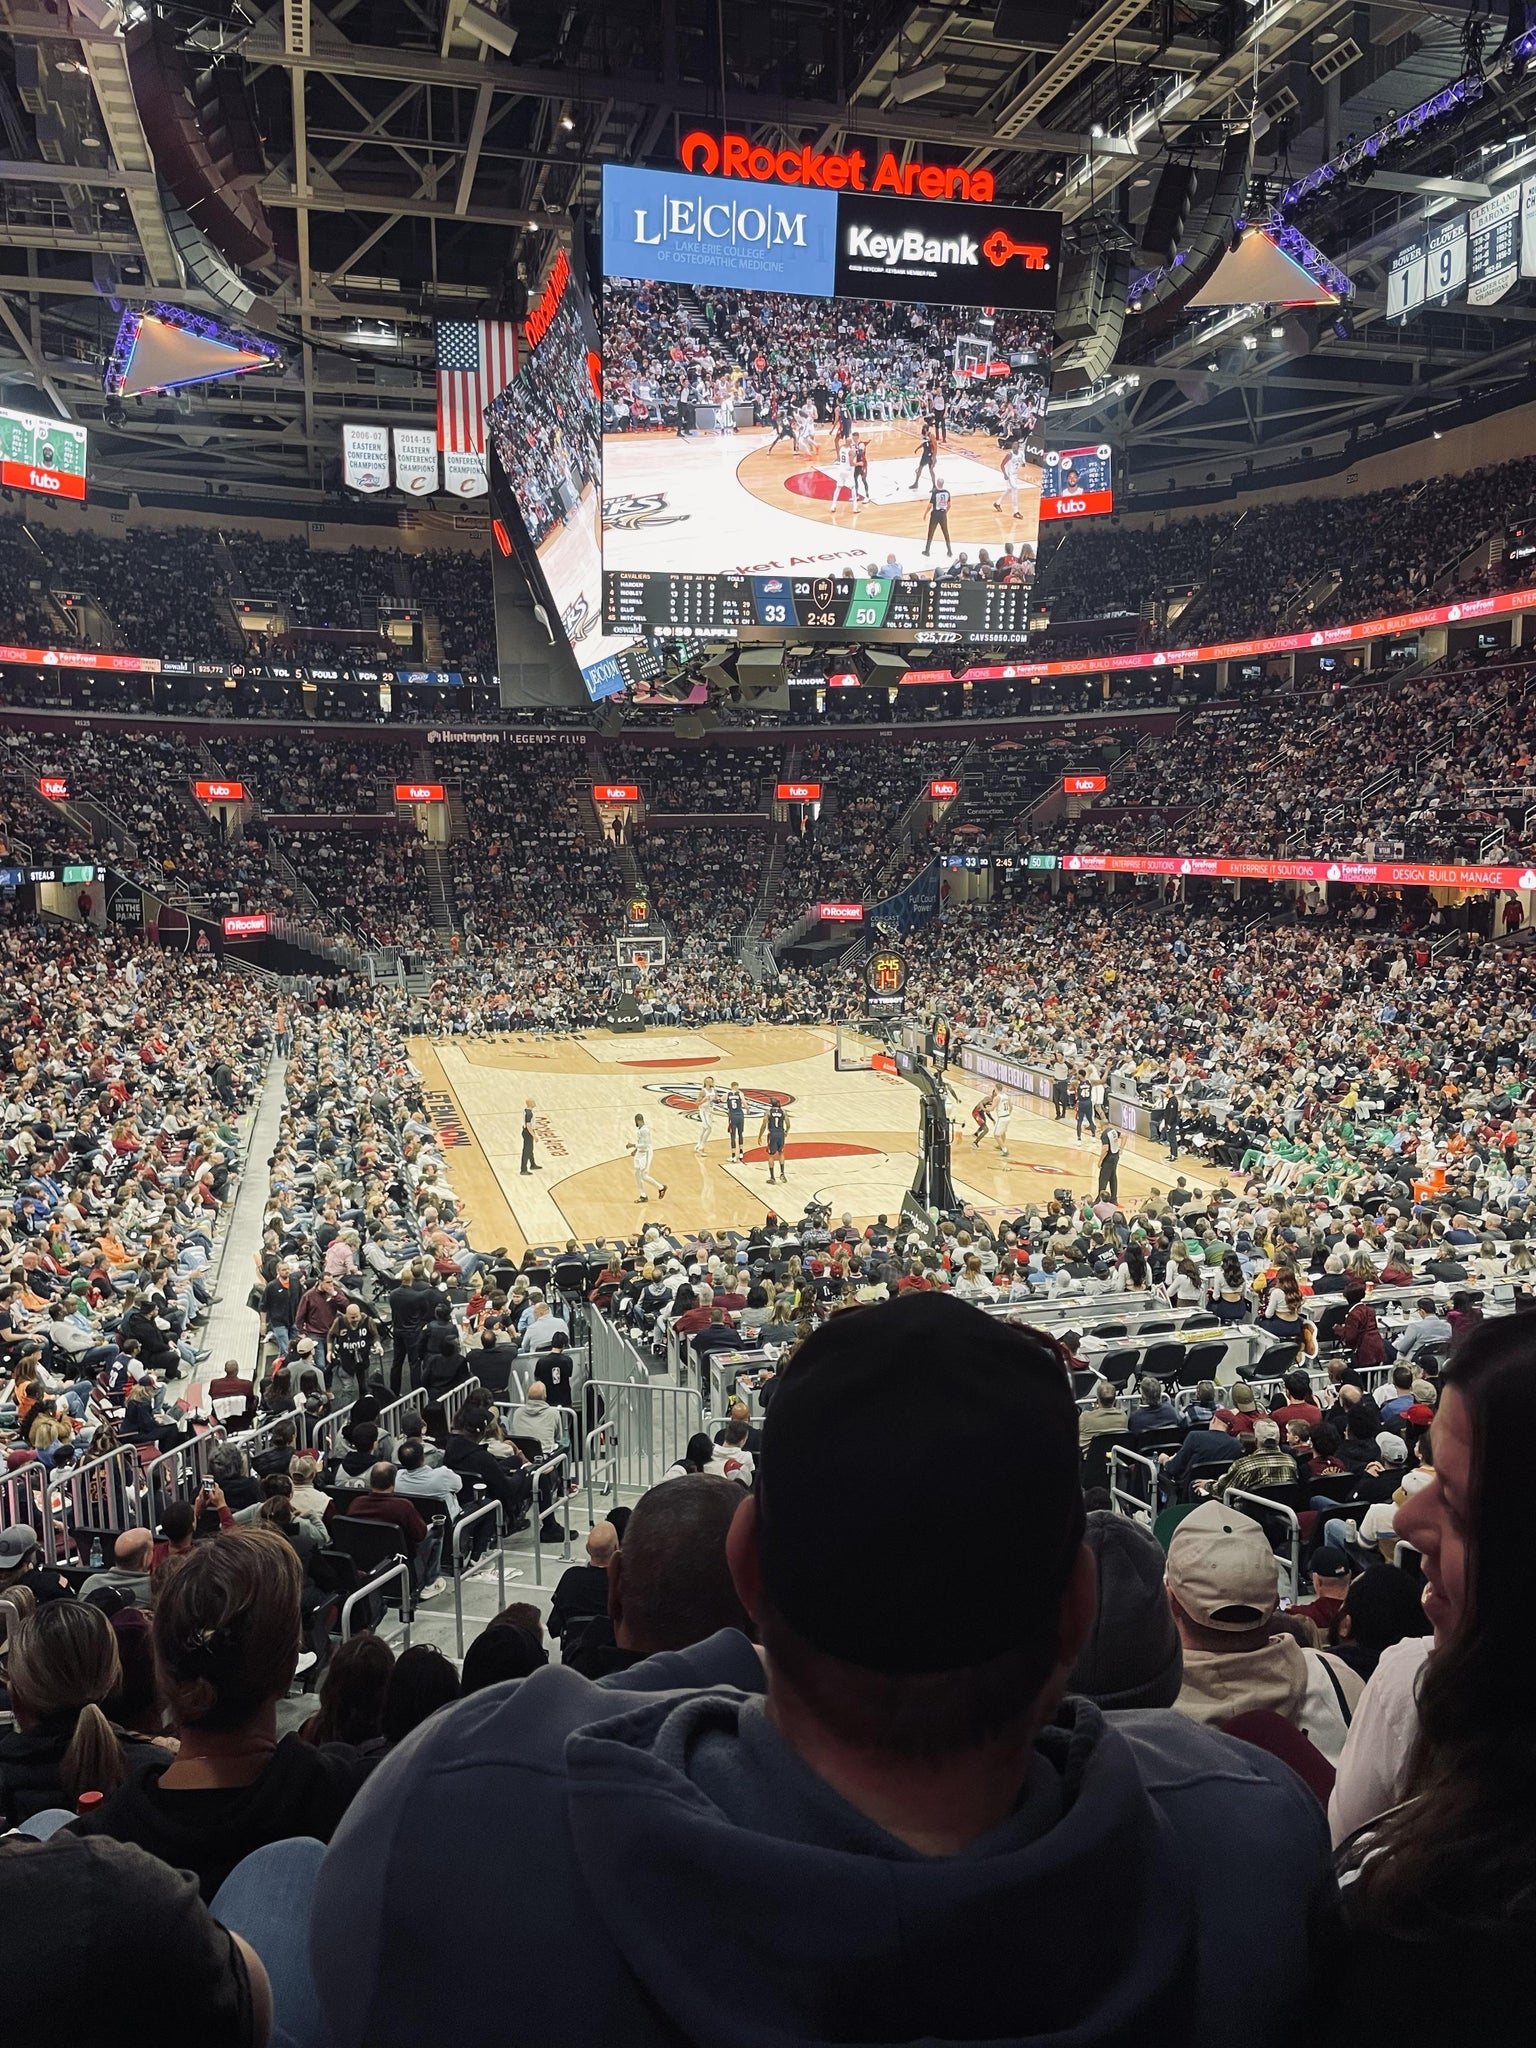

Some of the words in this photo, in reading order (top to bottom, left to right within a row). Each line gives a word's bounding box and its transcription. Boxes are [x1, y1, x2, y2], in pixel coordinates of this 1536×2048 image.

[722, 134, 866, 190] Rocket
[872, 151, 995, 202] Arena
[1471, 190, 1518, 220] CLEVELAND
[1478, 204, 1510, 227] BARONS
[1430, 224, 1465, 249] GLOVER
[848, 225, 979, 265] KeyBank
[675, 241, 700, 252] LAKE
[701, 243, 722, 255] ERIE
[723, 247, 765, 260] COLLEGE
[657, 250, 671, 261] OF
[672, 252, 737, 269] OSTEOPATHIC
[738, 258, 784, 273] MEDICINE
[1393, 247, 1421, 269] BOWER
[1440, 250, 1451, 287] 9
[1402, 270, 1409, 306] 1
[351, 431, 382, 440] 2006-07
[401, 435, 432, 444] 2014-15
[352, 442, 381, 450] EASTERN
[402, 446, 430, 454] EASTERN
[348, 451, 387, 461] CONFERENCE
[398, 454, 436, 464] CONFERENCE
[447, 456, 486, 466] CONFERENCE
[350, 460, 386, 470] CHAMPIONS
[400, 464, 435, 473] CHAMPIONS
[449, 466, 484, 475] CHAMPIONS
[30, 470, 60, 490] fubo
[1056, 499, 1086, 514] fubo
[790, 548, 868, 566] Arena
[795, 583, 810, 594] 2Q
[837, 584, 849, 594] 14
[1462, 599, 1494, 612] ForeFront
[765, 605, 786, 622] 33
[857, 608, 876, 624] 50
[807, 613, 836, 626] 2:45
[613, 623, 642, 634] oswald
[694, 627, 738, 637] RAFFLE
[1324, 628, 1352, 639] ForeFront
[917, 632, 957, 645] $25,772
[970, 633, 1028, 643] CAVS5050.COM
[1167, 650, 1199, 660] ForeFront
[1213, 645, 1251, 657] ENTERPRISE
[1252, 643, 1261, 652] IT
[59, 652, 97, 663] ForeFront
[112, 659, 141, 669] DESIGN
[164, 662, 188, 671] oswald
[199, 665, 224, 674] $25,772
[249, 668, 262, 676] -17
[273, 669, 290, 677] TOL
[295, 669, 302, 679] 5
[1016, 665, 1048, 674] ForeFront
[312, 671, 337, 680] FOULS
[382, 673, 394, 682] 29
[437, 674, 449, 683] 33
[468, 675, 478, 683] 14
[799, 677, 826, 686] KNOW.
[442, 731, 499, 743] Huntington
[510, 734, 557, 744] LEGENDS
[559, 735, 586, 744] CLUB
[935, 784, 954, 794] fubo
[1075, 779, 1095, 790] fubo
[209, 785, 230, 796] fubo
[409, 787, 431, 798] fubo
[606, 787, 626, 798] fubo
[789, 787, 808, 797] fubo
[965, 857, 976, 867] 33
[995, 858, 1013, 867] 2:45
[1020, 858, 1028, 866] 14
[1032, 858, 1041, 867] 50
[1081, 856, 1106, 866] ForeFront
[1111, 860, 1140, 869] ENTERPRISE
[1191, 859, 1217, 869] ForeFront
[1230, 863, 1268, 875] ENTERPRISE
[1277, 864, 1314, 876] SOUTIONS
[1342, 864, 1377, 875] ForeFront
[30, 871, 55, 881] STEALS
[1342, 873, 1377, 882] TECHNOLOGY
[909, 894, 920, 904] Full
[920, 895, 936, 903] Court
[115, 903, 124, 912] IN
[125, 903, 140, 912] THE
[830, 907, 860, 916] Rocket
[913, 903, 932, 912] Power
[116, 913, 141, 921] PAINT
[635, 908, 646, 919] 14
[235, 918, 265, 931] Rocket
[881, 970, 897, 989] 14
[1080, 1088, 1090, 1097] 45
[731, 1099, 738, 1109] 5
[774, 1117, 779, 1128] 1
[1420, 1192, 1429, 1201] G
[359, 1328, 367, 1336] 10
